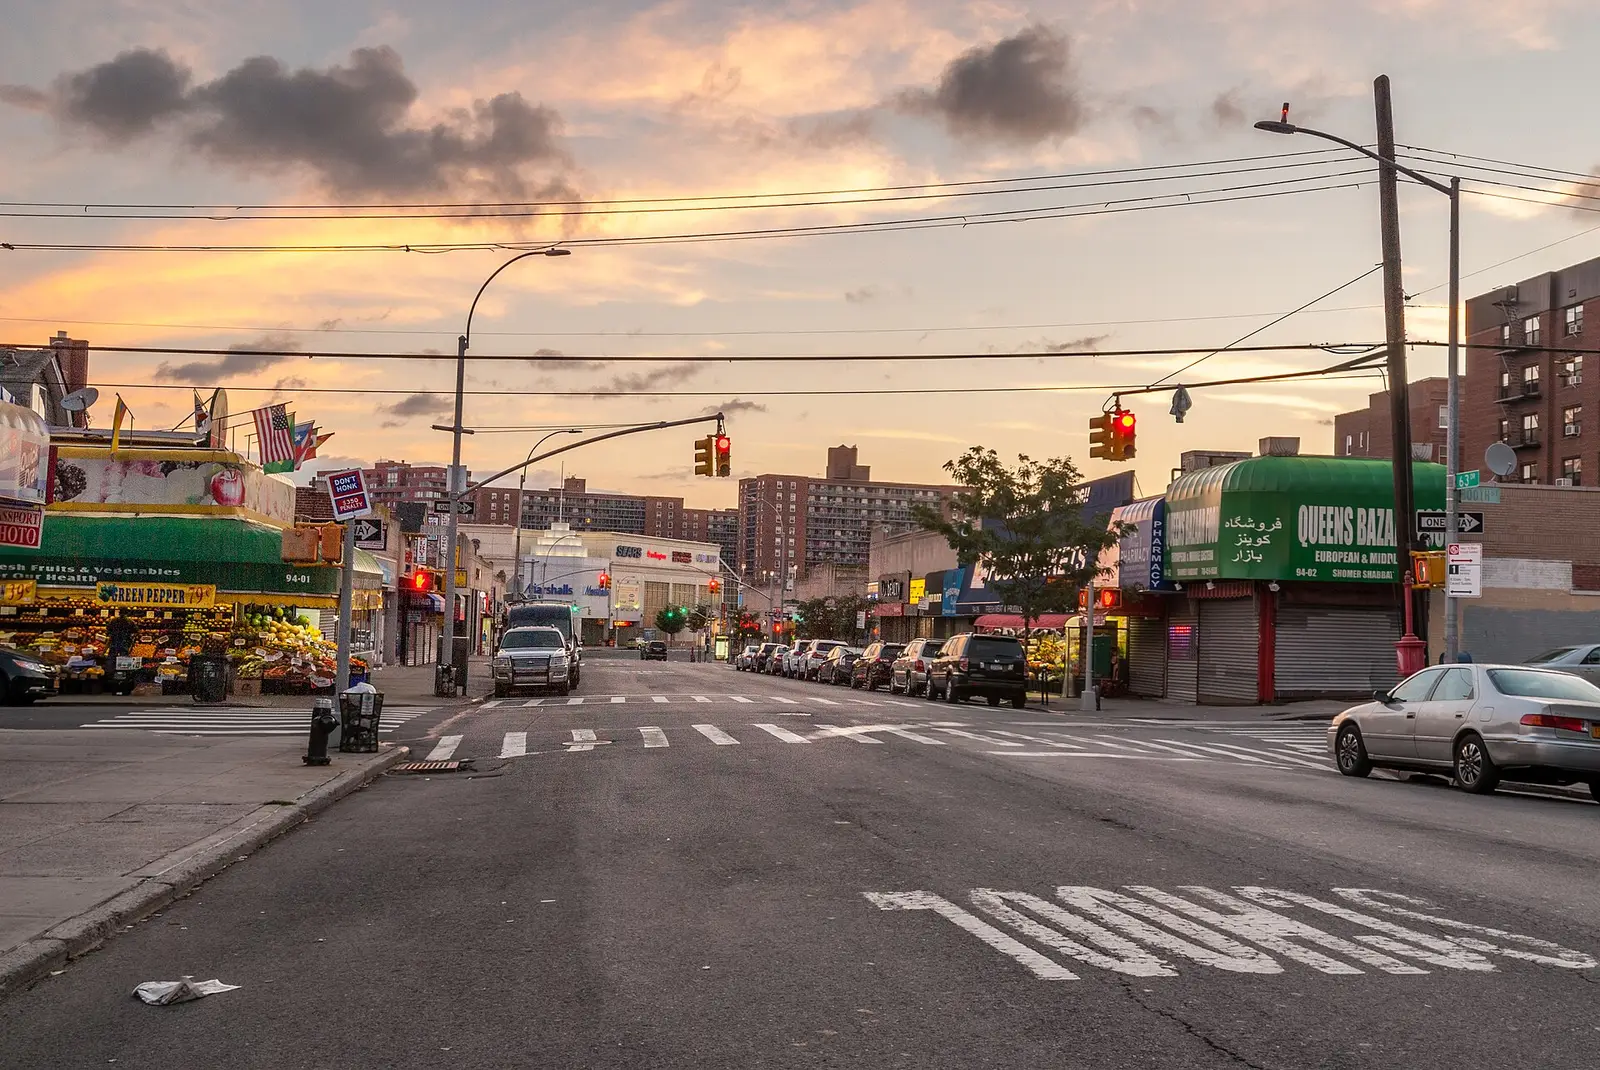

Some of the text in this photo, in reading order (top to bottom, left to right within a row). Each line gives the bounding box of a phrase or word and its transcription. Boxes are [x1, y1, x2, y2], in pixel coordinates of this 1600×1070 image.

[334, 475, 356, 486] DON'T
[1459, 474, 1469, 487] 63
[336, 483, 358, 493] HONK
[340, 502, 363, 511] PENALTY
[342, 497, 359, 506] $350
[1224, 516, 1283, 532] فروشگاه
[1298, 504, 1354, 547] QUEENS
[1356, 507, 1397, 546] BAZA
[1426, 518, 1445, 527] ONE
[616, 545, 642, 559] SEARS
[1151, 521, 1162, 588] PHARMACY
[1231, 550, 1263, 564] بازار
[1315, 550, 1359, 564] EUROPEAN
[1361, 552, 1368, 563] &
[31, 564, 75, 573] Fruits
[79, 565, 90, 573] &
[94, 566, 181, 576] Vegetables
[1296, 568, 1317, 578] 94-02
[1332, 569, 1361, 579] SHOMER
[46, 574, 98, 582] Health
[286, 574, 310, 583] 94-01
[111, 586, 144, 603] GREEN
[146, 588, 185, 604] PEPPER
